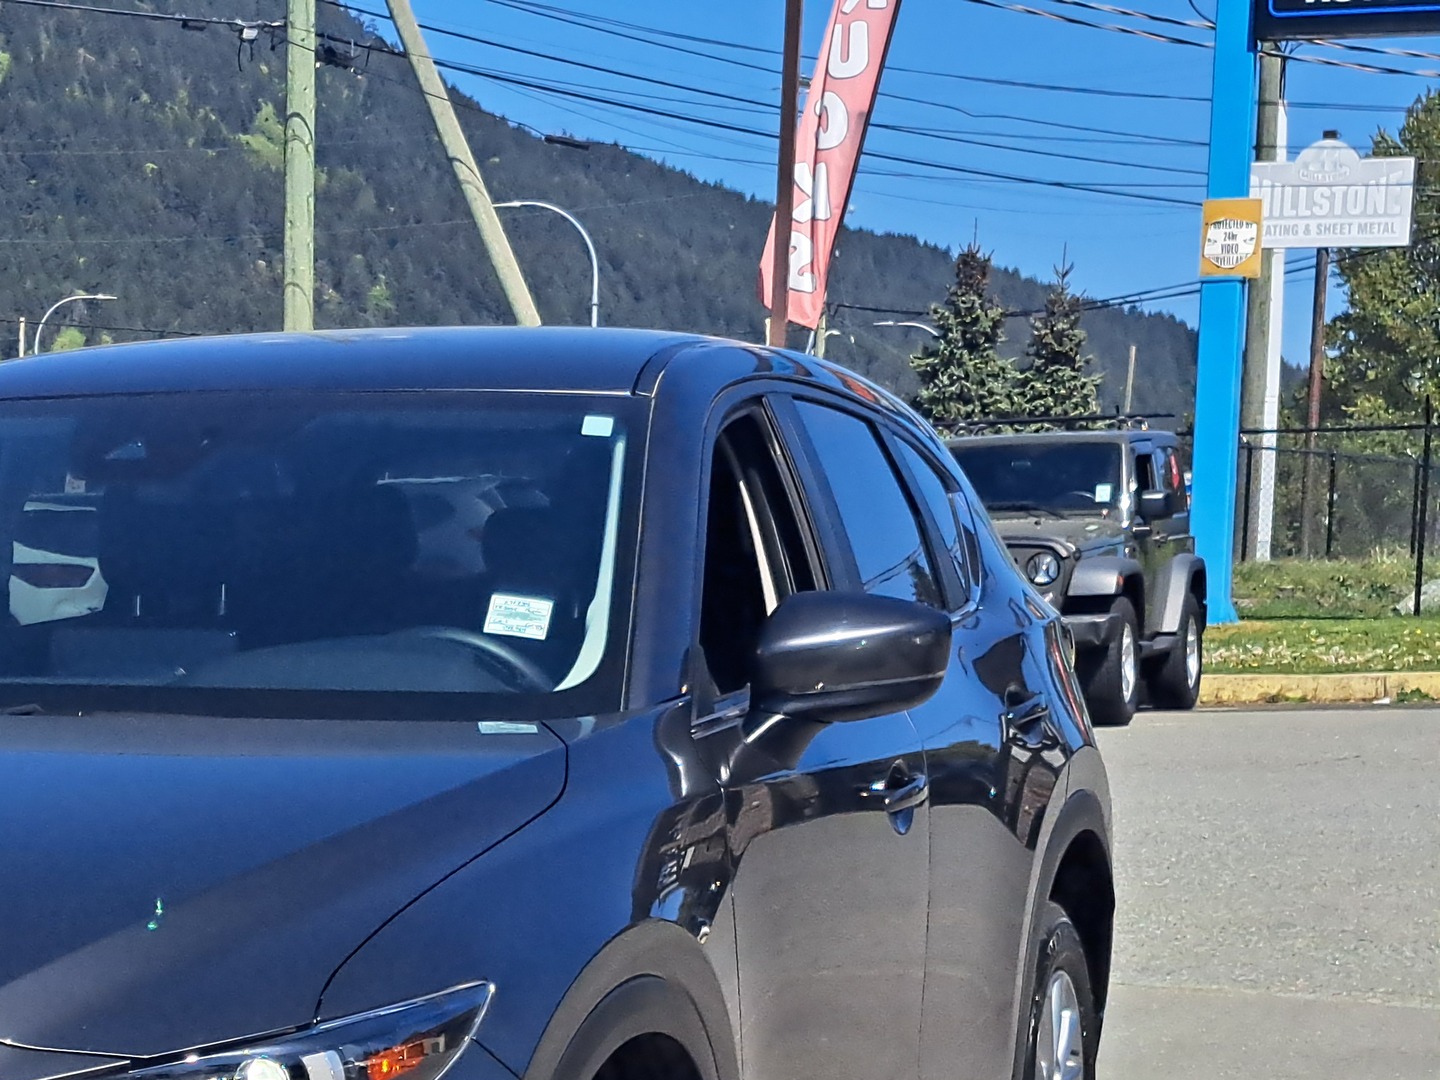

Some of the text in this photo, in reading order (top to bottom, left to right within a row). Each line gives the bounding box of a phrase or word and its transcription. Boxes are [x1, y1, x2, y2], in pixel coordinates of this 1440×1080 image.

[1263, 221, 1396, 237] ATING & SHEET METAL
[1220, 243, 1239, 255] VIDEO
